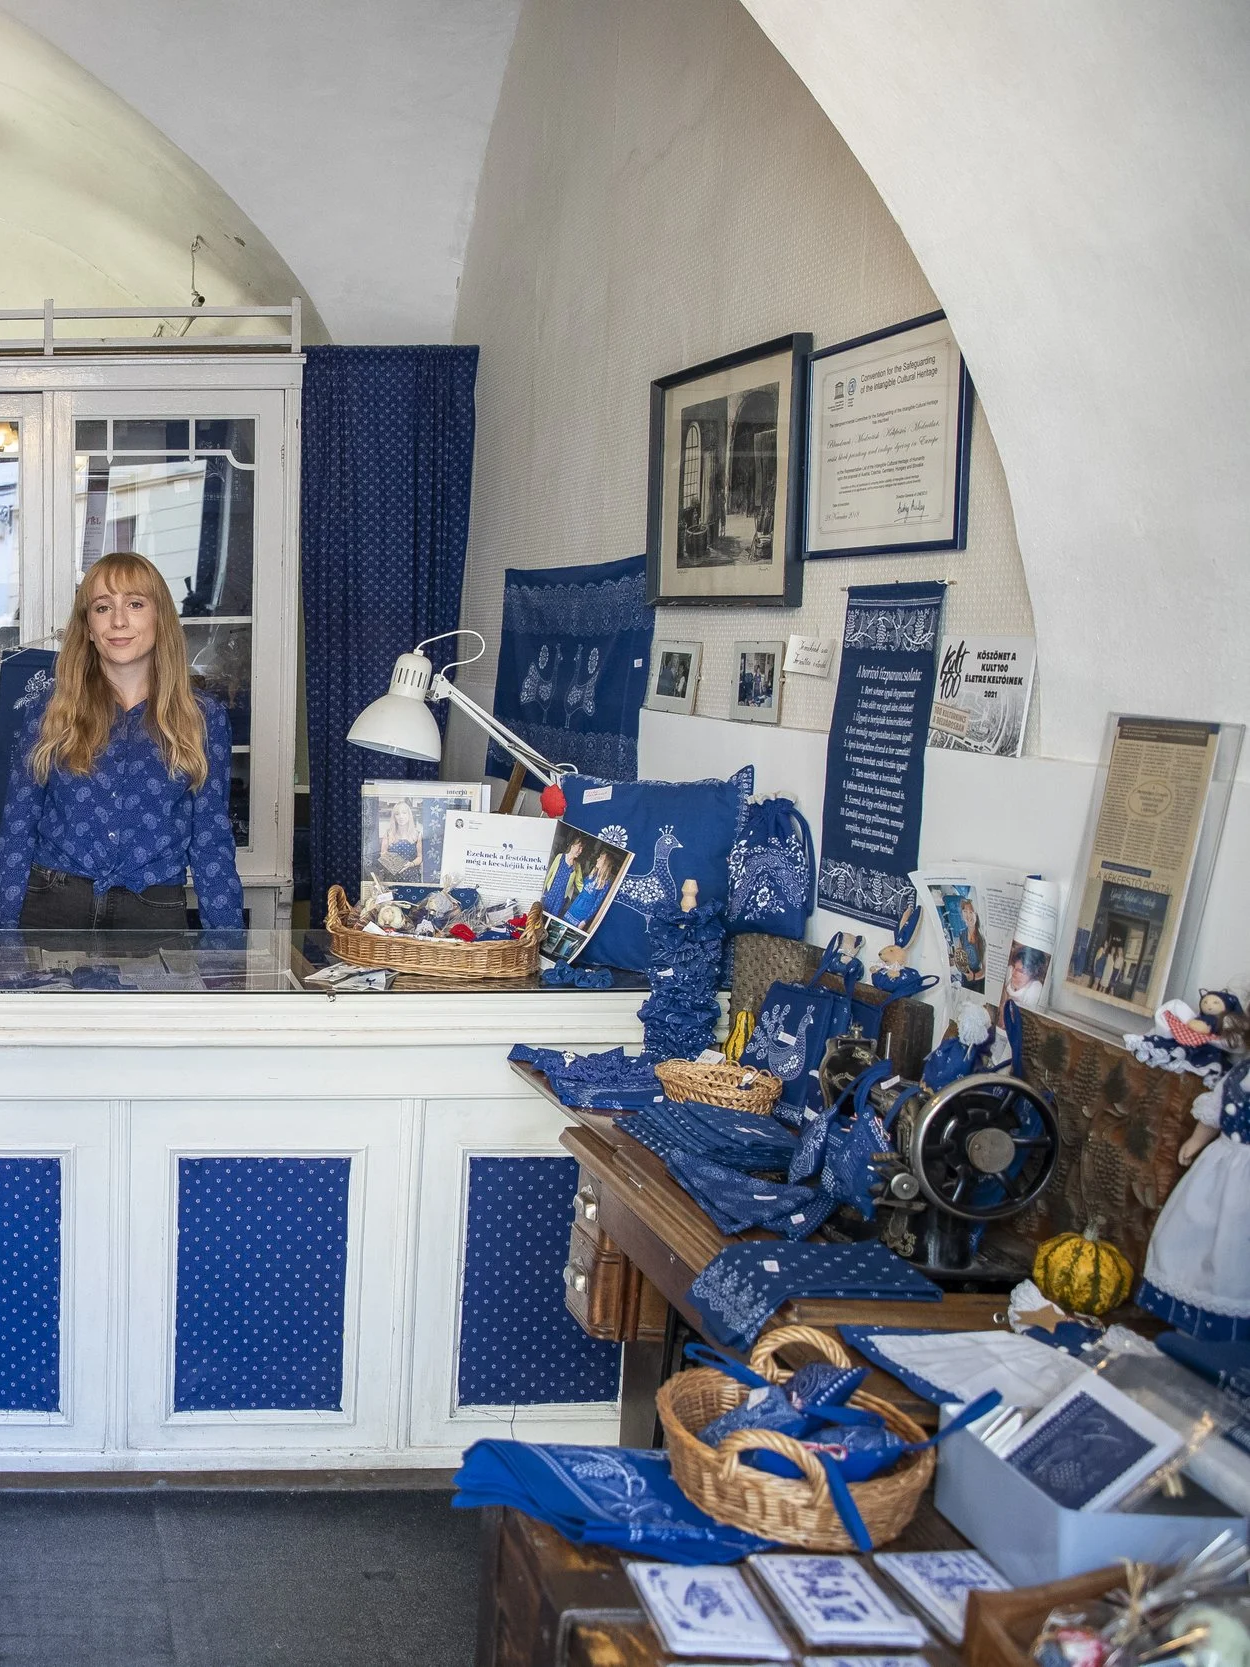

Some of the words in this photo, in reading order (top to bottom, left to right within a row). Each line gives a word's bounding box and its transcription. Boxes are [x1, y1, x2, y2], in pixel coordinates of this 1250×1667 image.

[861, 370, 886, 383] Convention
[903, 356, 936, 371] Safeguarding
[860, 386, 865, 394] of
[874, 378, 896, 391] Intangible
[897, 372, 916, 384] Cultural
[917, 367, 938, 379] Heritage
[977, 650, 1010, 661] KÖSZÖNET
[1011, 653, 1016, 661] A
[965, 673, 986, 684] ÉLETRE
[984, 690, 998, 698] 2021
[466, 850, 498, 860] Ezeknek
[506, 854, 542, 864] festőknek
[466, 858, 482, 866] még
[488, 859, 525, 870] kecskéjük
[535, 863, 548, 872] kék
[1096, 871, 1102, 880] A
